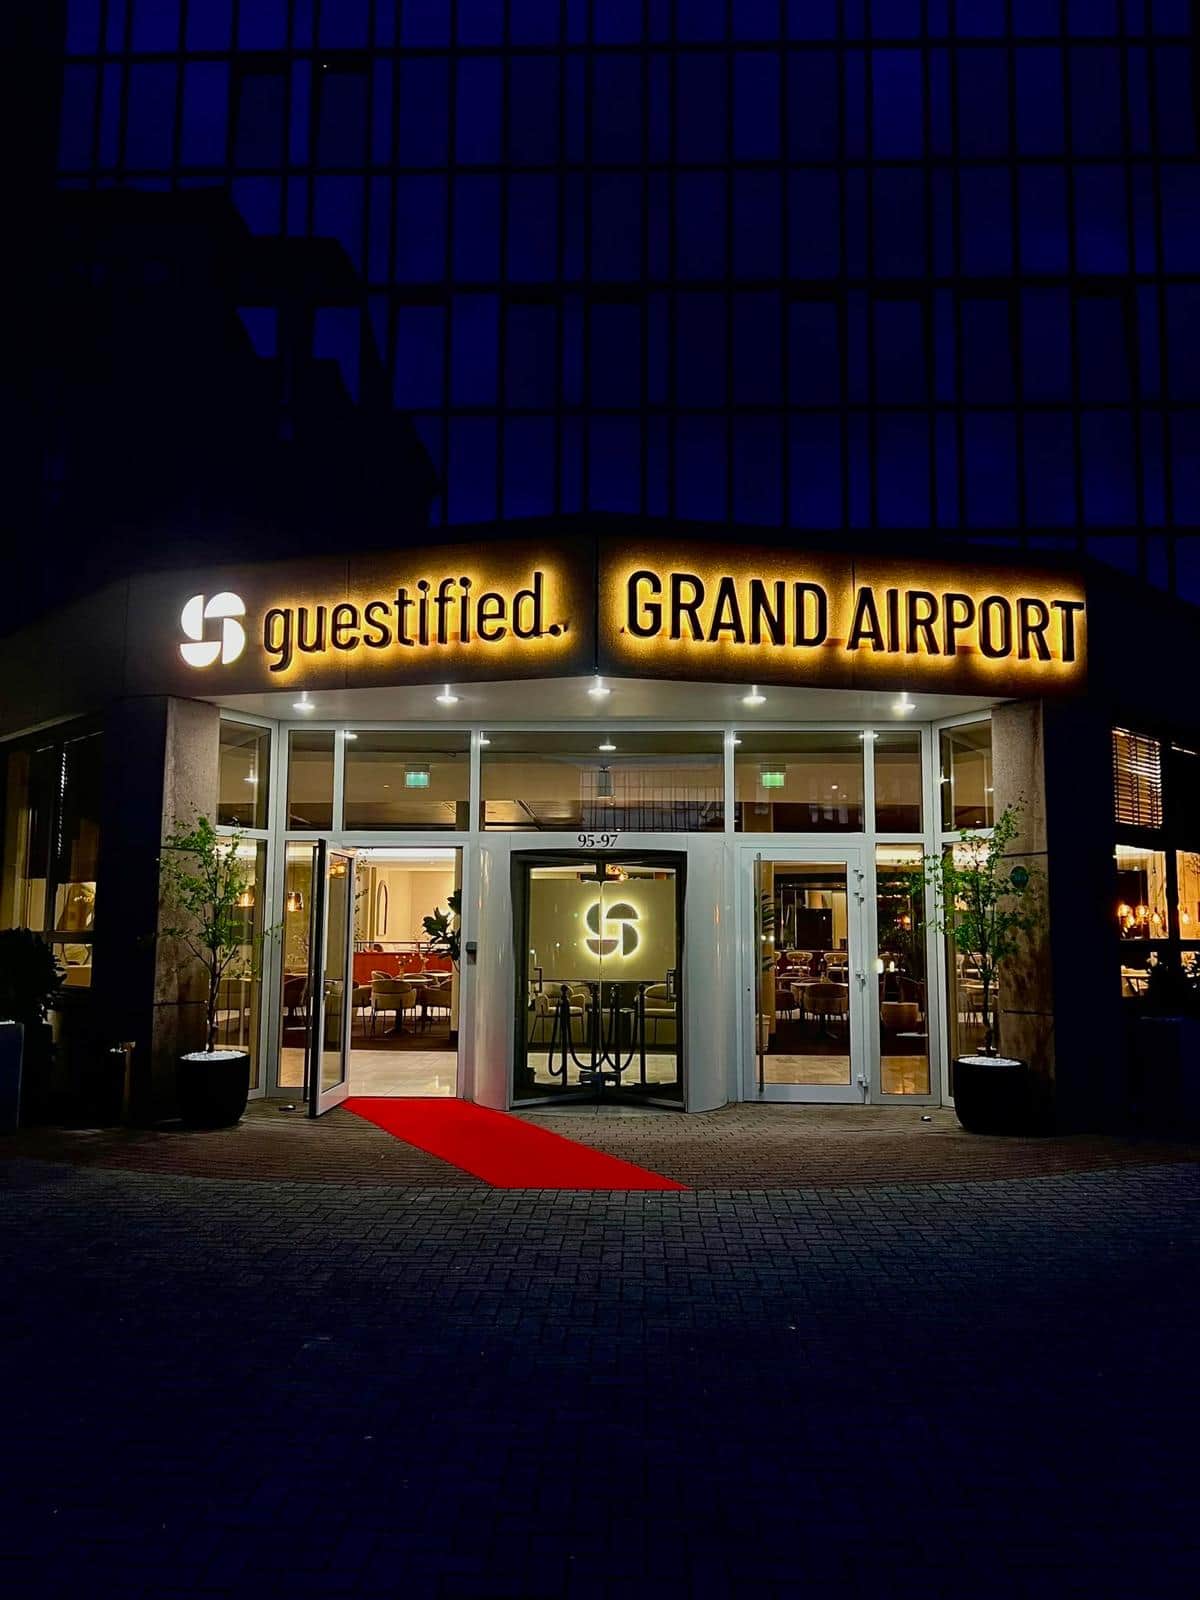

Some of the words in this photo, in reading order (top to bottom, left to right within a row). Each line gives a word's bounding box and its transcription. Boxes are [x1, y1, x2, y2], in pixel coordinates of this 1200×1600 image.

[626, 570, 828, 648] GRAND
[847, 586, 1085, 662] AIRPORT
[577, 834, 618, 847] 95-97
